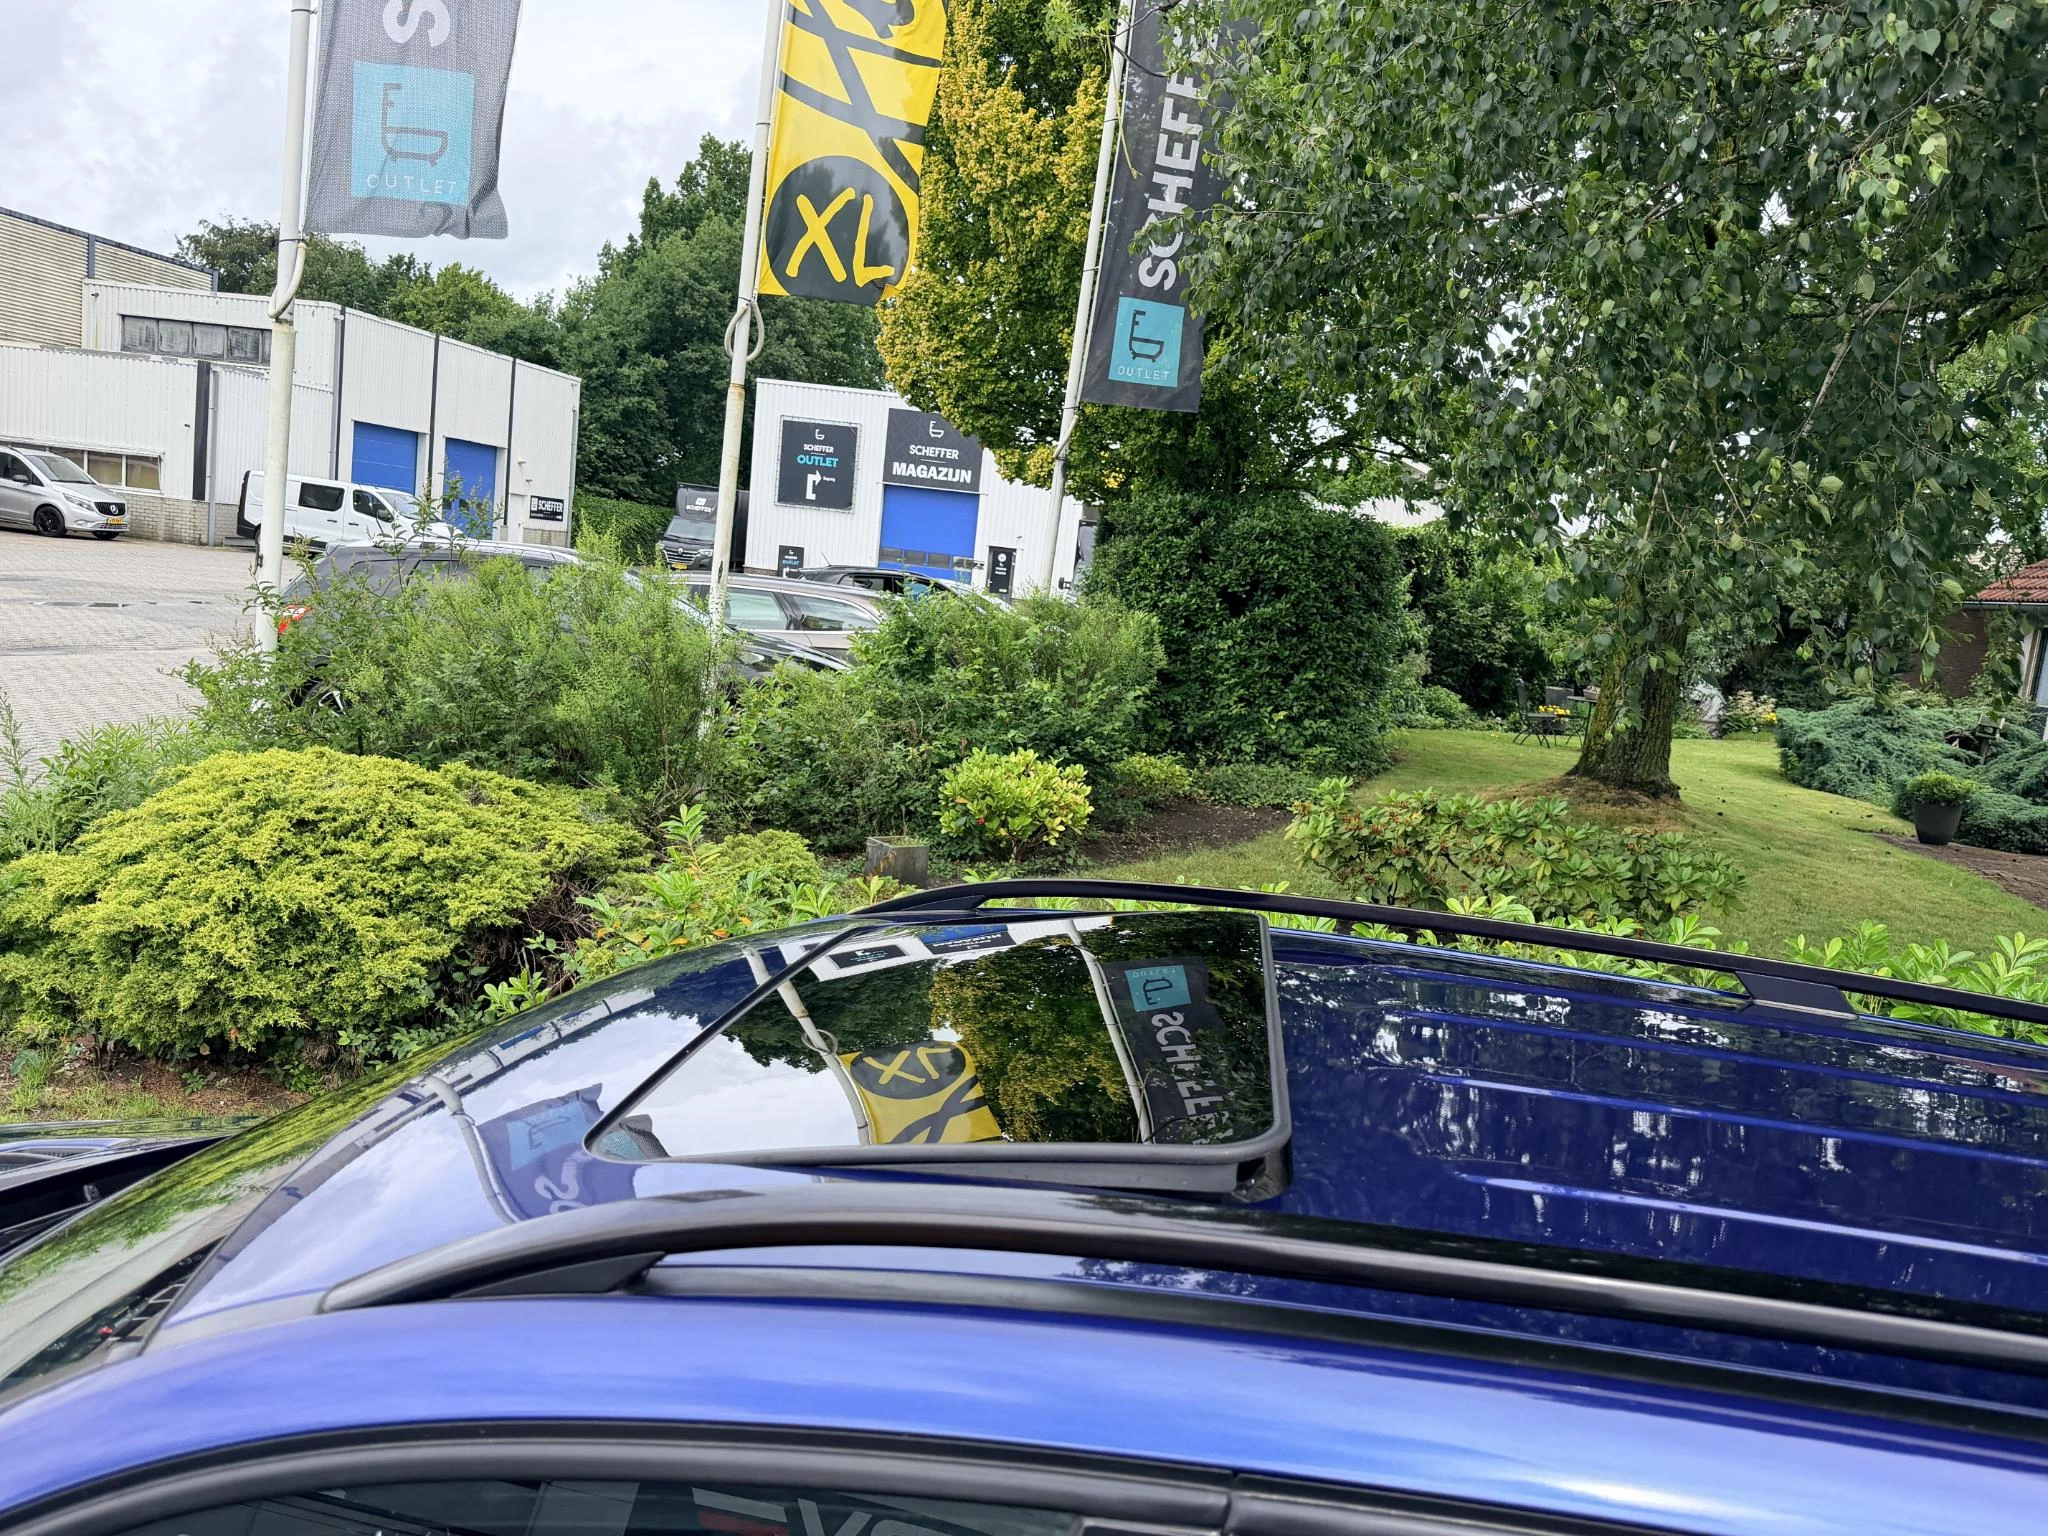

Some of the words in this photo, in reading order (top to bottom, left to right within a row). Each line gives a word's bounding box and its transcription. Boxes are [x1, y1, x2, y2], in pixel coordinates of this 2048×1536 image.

[1138, 0, 1219, 291] SCHEFF
[367, 174, 457, 195] OUTLET
[785, 187, 896, 288] XL
[1116, 365, 1171, 382] OUTLET
[803, 443, 835, 454] SCHEFFER
[909, 444, 960, 460] SCHEFFER
[797, 454, 839, 468] OUTLET
[892, 461, 972, 484] MAGAZIJN
[538, 500, 563, 513] SCHEFFER
